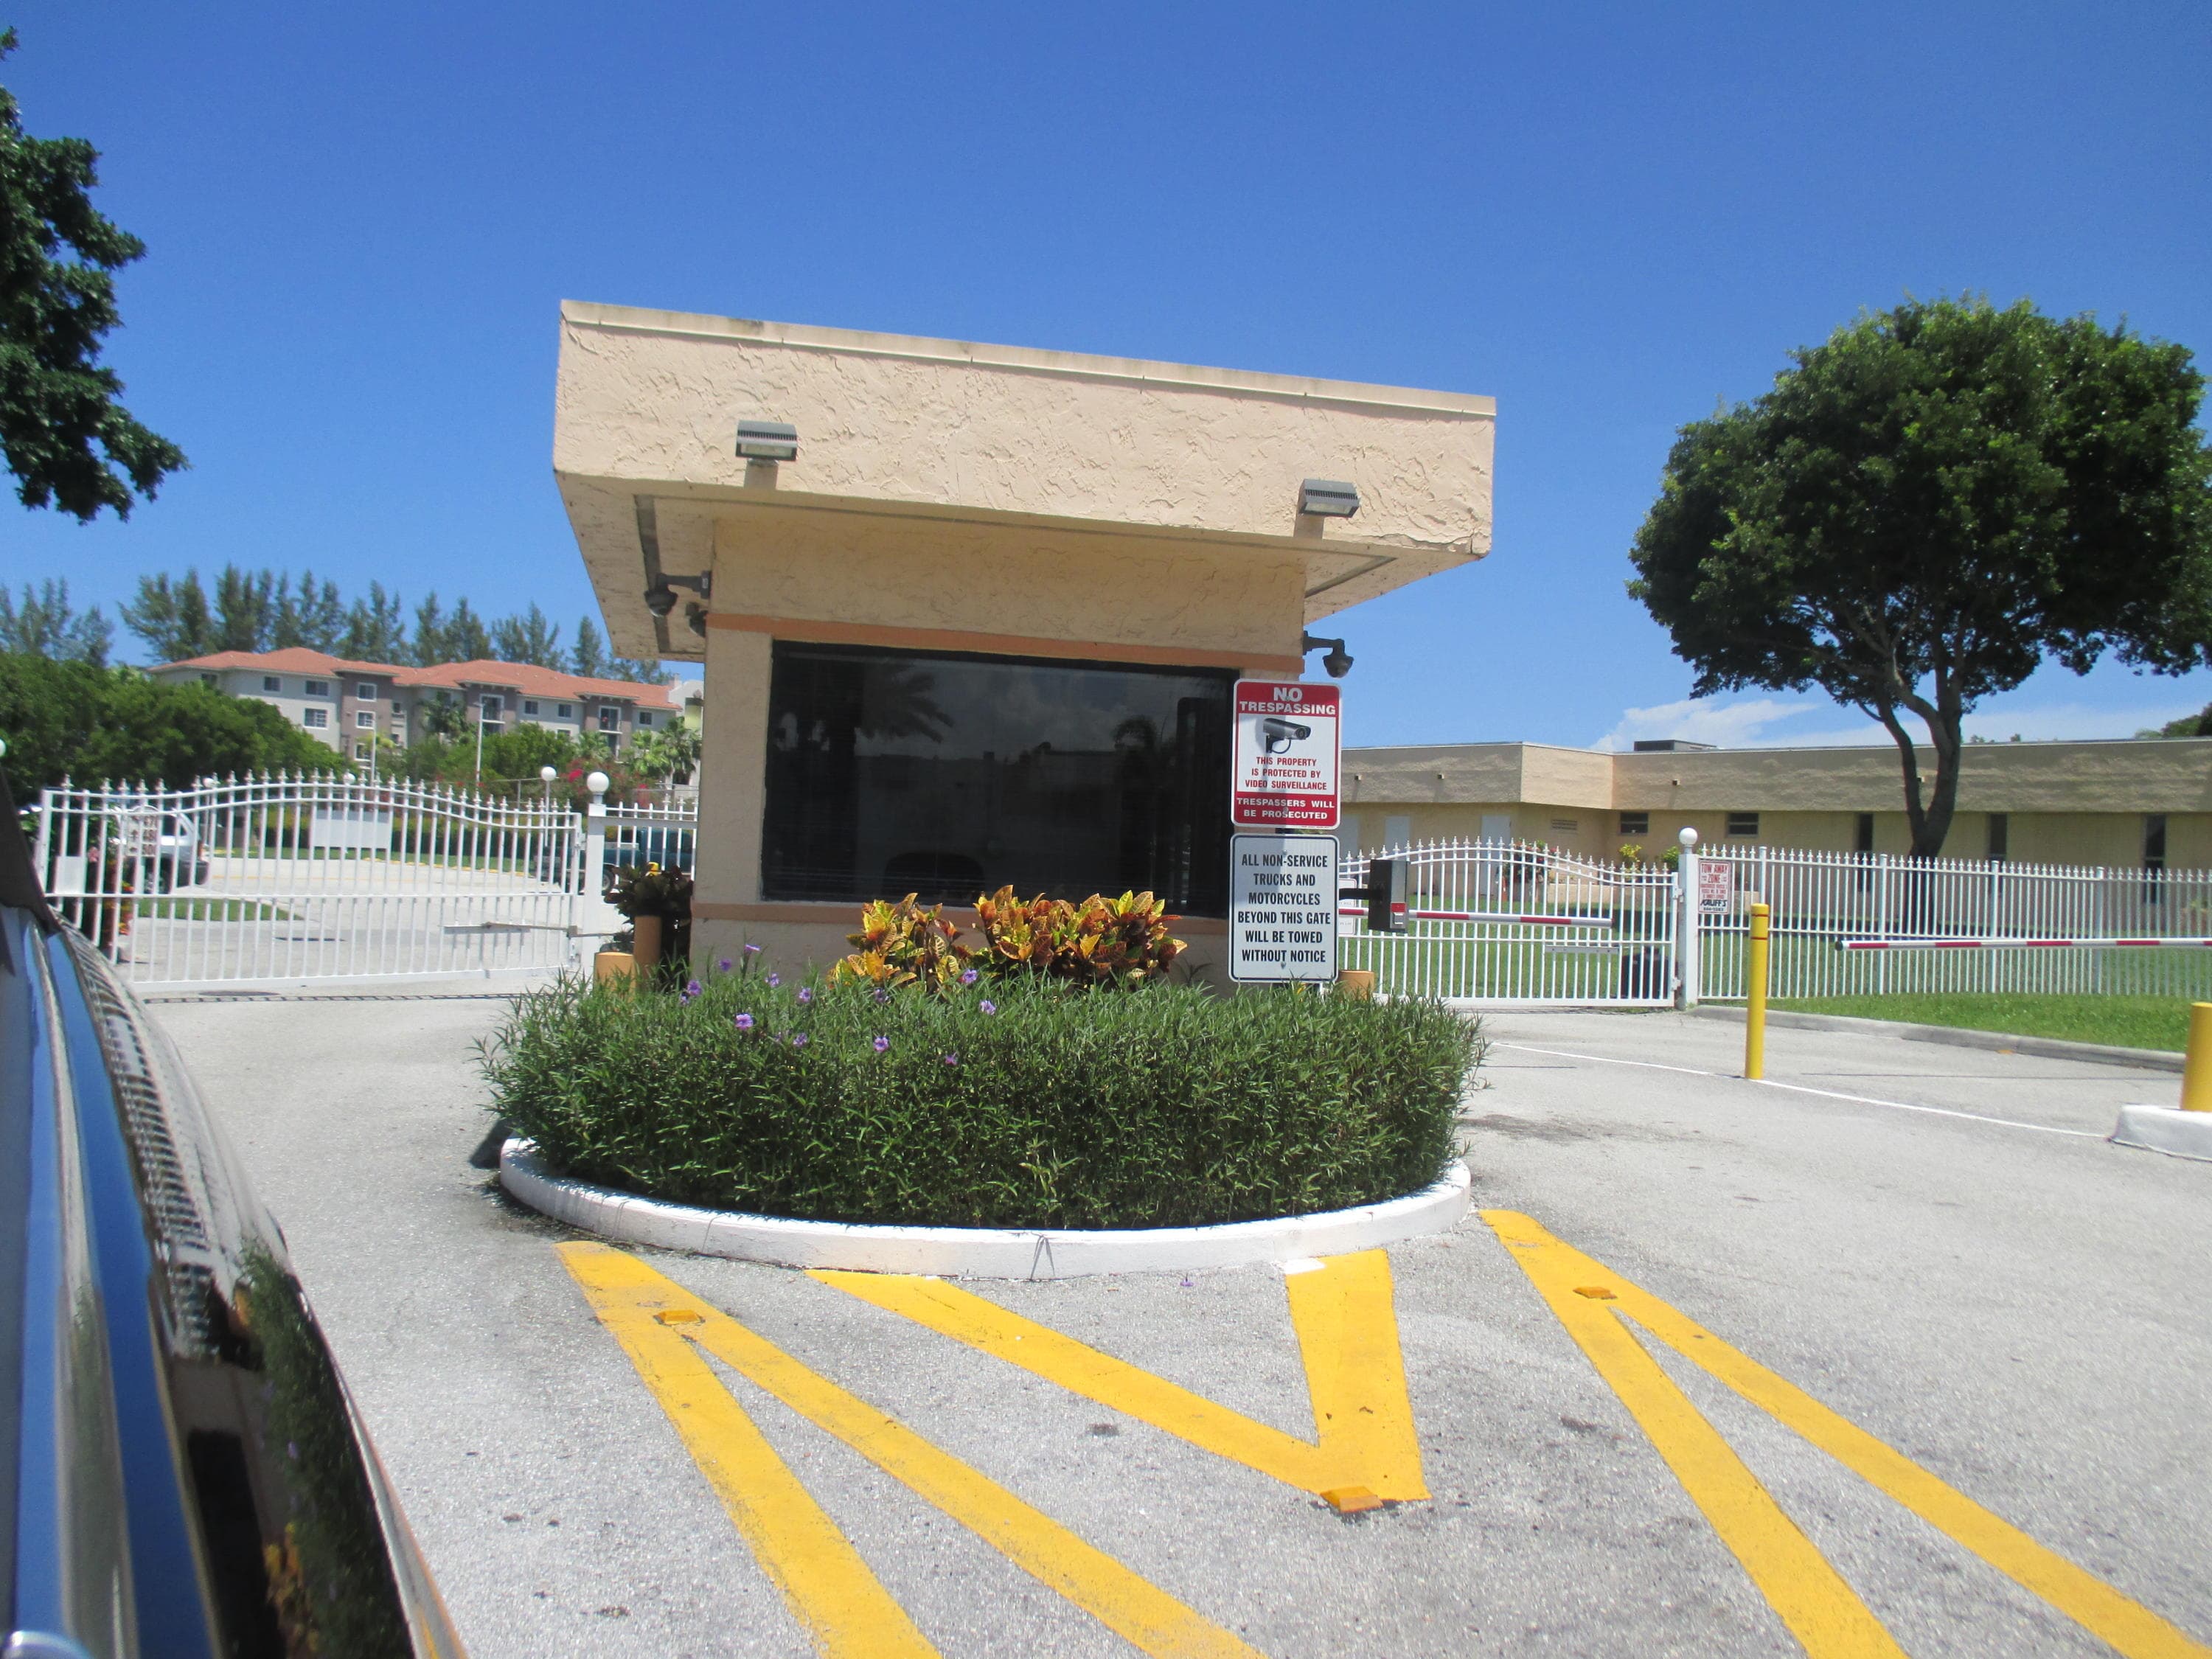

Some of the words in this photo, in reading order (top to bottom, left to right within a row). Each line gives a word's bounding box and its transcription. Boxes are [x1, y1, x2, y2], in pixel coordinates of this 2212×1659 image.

[1273, 686, 1303, 702] NO
[1239, 701, 1336, 714] TRESPASSING
[1256, 757, 1273, 765] THIS
[1277, 757, 1317, 766] PROPERTY
[1262, 768, 1307, 778] PROTECTED
[1311, 771, 1321, 779] BY
[1245, 779, 1267, 787] VIDEO
[1271, 781, 1327, 790] SURVEILLANCE
[1237, 797, 1306, 807] TRESPASSERS
[1311, 800, 1335, 808] WILL
[1262, 810, 1328, 819] PROSECUTED
[1242, 854, 1259, 866] ALL
[1262, 854, 1328, 867] NON-SERVICE
[1702, 863, 1711, 873] TOW
[1253, 873, 1293, 886] TRUCKS
[1295, 874, 1315, 886] AND
[1708, 874, 1720, 883] ZONE
[1248, 892, 1321, 905] MOTORCYCLES
[1238, 911, 1277, 924] BEYOND
[1281, 911, 1303, 925] THIS
[1307, 912, 1331, 925] GATE
[1245, 930, 1269, 942] WILL
[1273, 931, 1284, 943] BE
[1288, 931, 1323, 943] TOWED
[1242, 949, 1287, 962] WITHOUT
[1290, 950, 1326, 962] NOTICE
